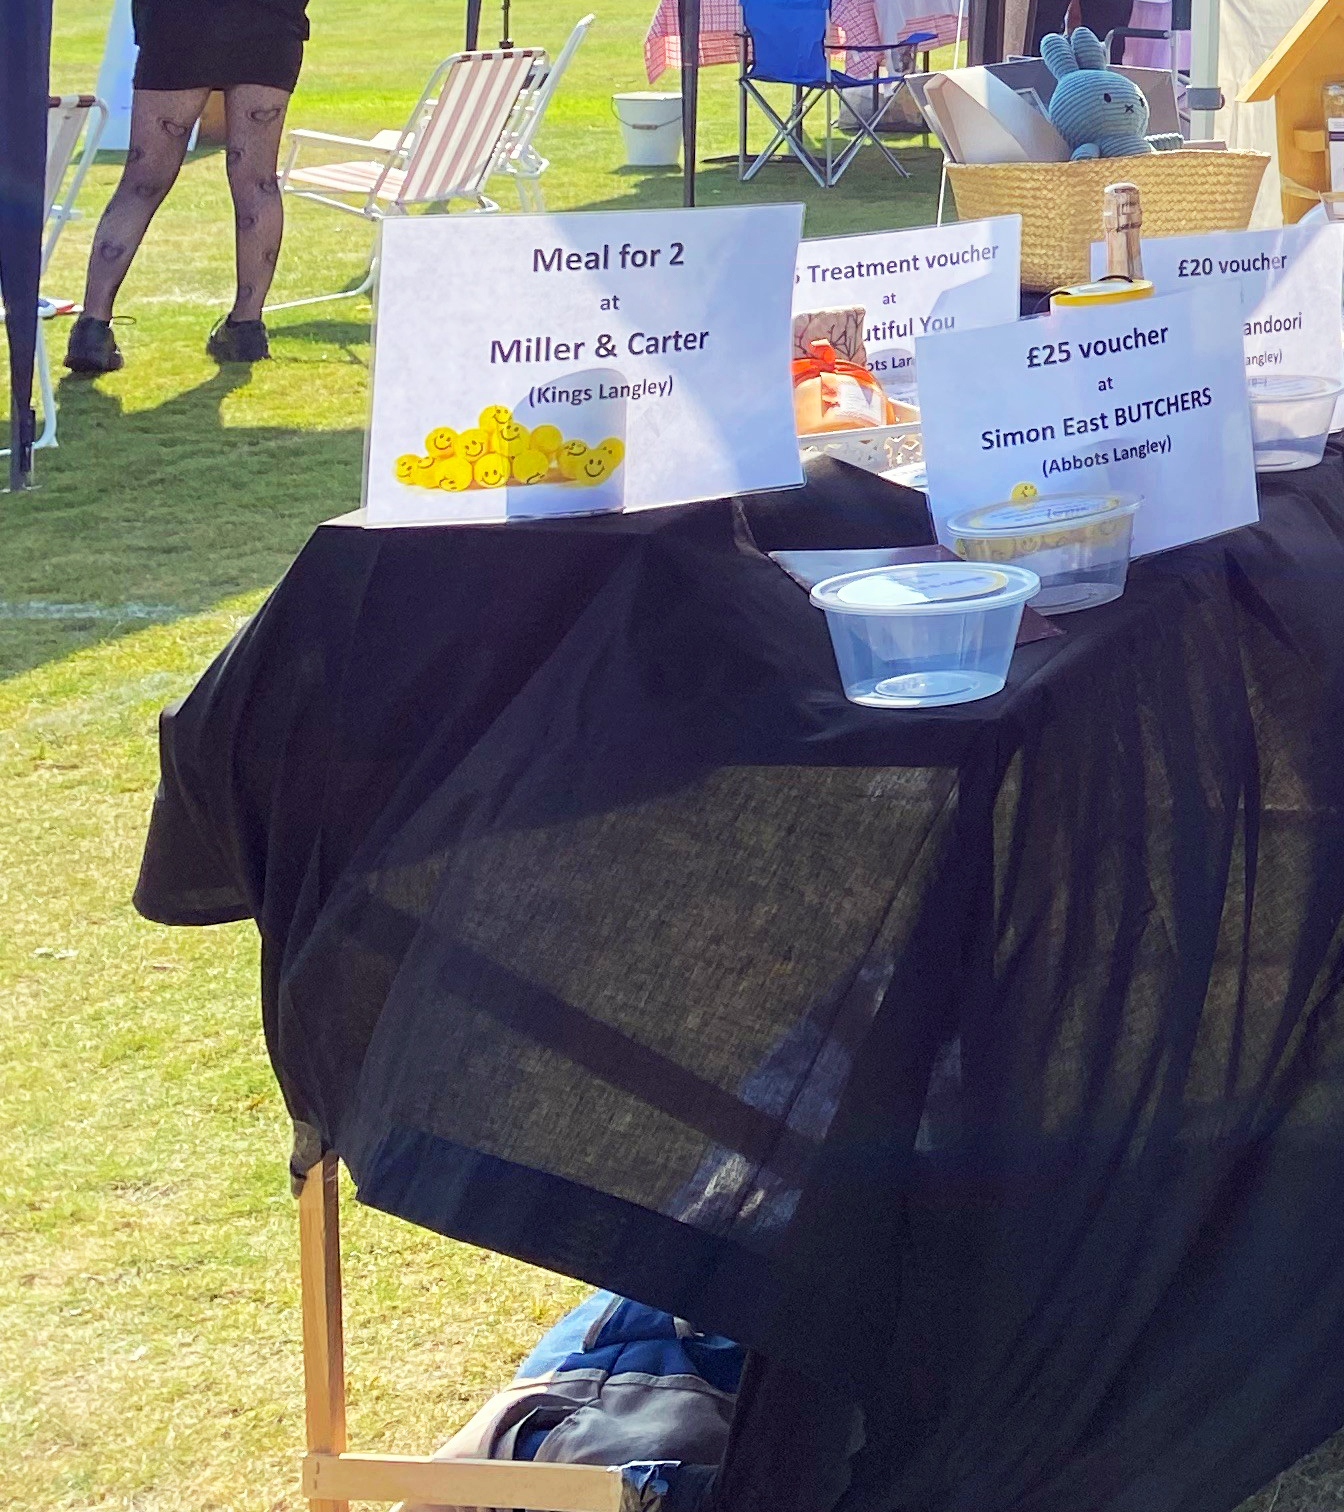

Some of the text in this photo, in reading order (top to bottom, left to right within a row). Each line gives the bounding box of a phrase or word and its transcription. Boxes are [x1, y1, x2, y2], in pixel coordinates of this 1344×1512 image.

[532, 242, 685, 273] Meal for 2
[807, 254, 920, 284] Treatment
[925, 243, 999, 269] voucher
[1177, 252, 1287, 278] £20 voucher
[599, 295, 620, 312] at
[882, 292, 897, 305] at
[920, 315, 955, 333] You
[490, 328, 710, 365] Miller & Carter
[1027, 325, 1169, 369] £25 voucher
[528, 375, 674, 409] (Kings Langley)
[1097, 376, 1114, 392] at
[981, 387, 1212, 451] Simon East BUTCHERS
[1042, 435, 1172, 478] (Abbots Langley)
